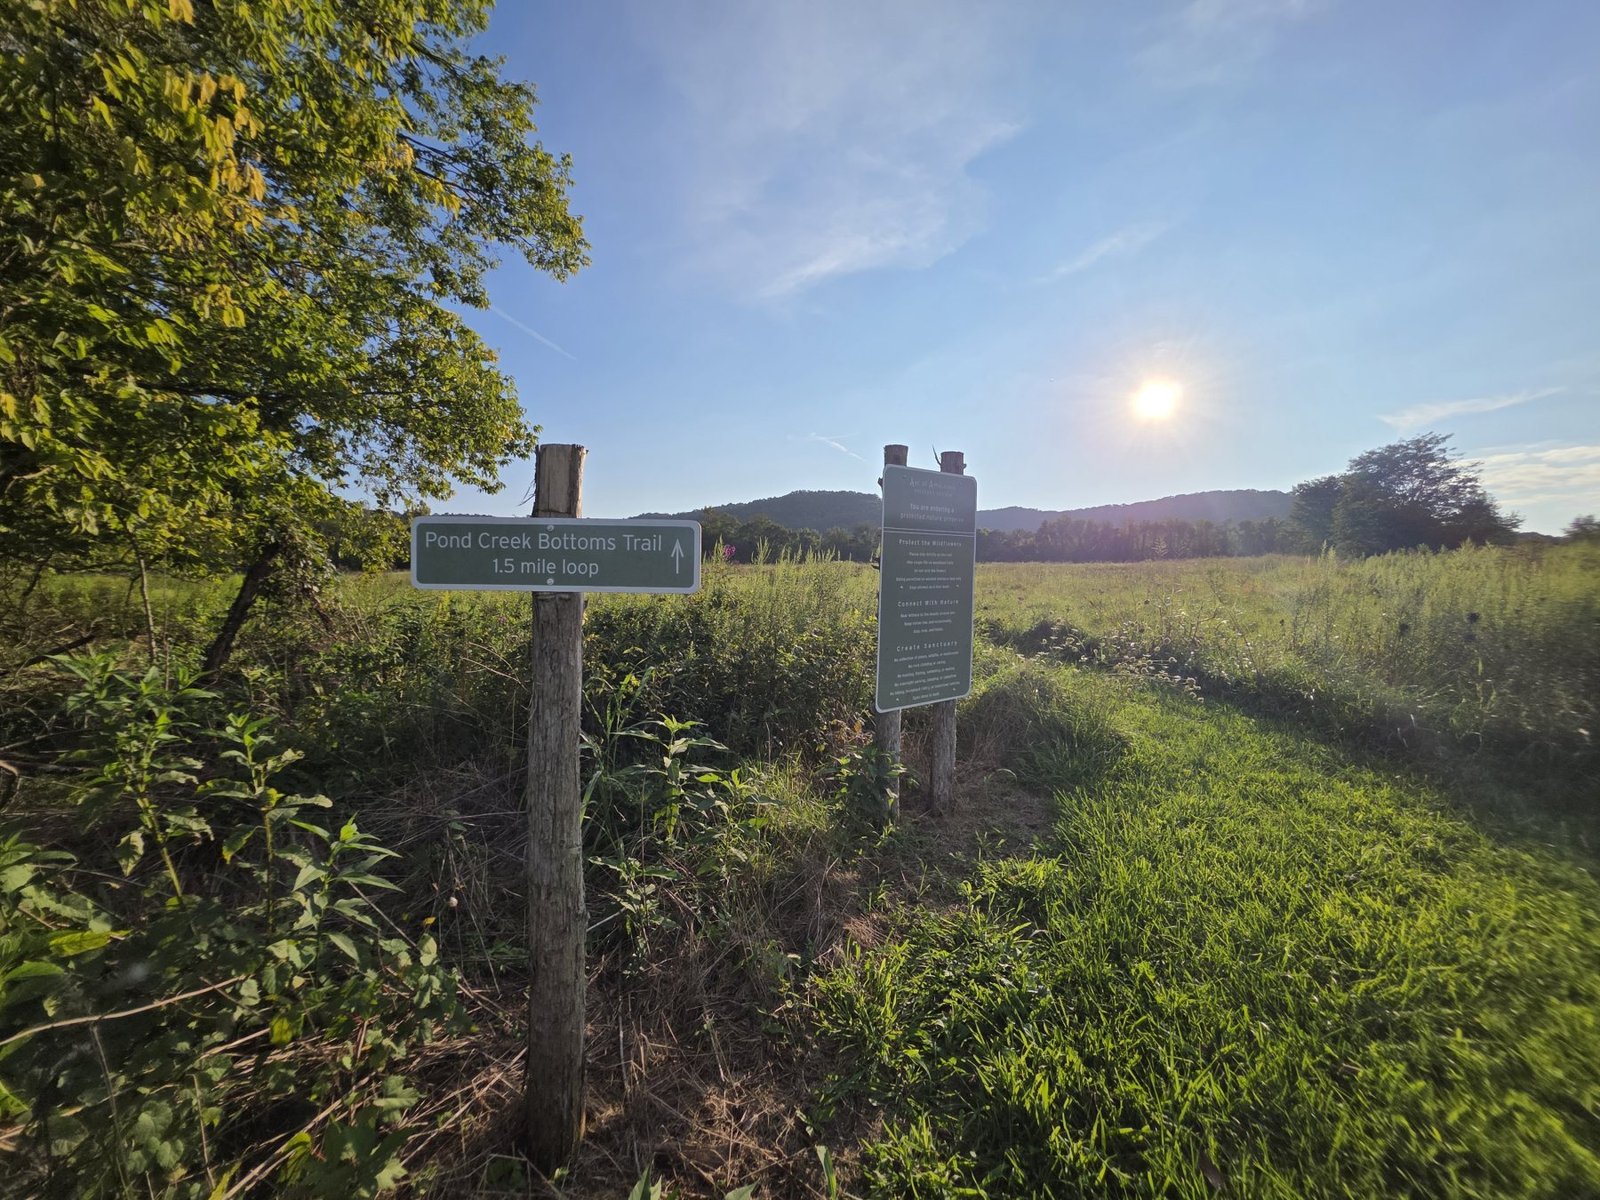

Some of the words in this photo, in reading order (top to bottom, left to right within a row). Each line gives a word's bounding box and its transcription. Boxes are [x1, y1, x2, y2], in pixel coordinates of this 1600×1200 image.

[425, 532, 472, 549] Pond
[478, 532, 532, 550] Creek
[538, 533, 616, 551] Bottoms
[622, 534, 662, 551] Trail
[493, 558, 514, 573] 1.5
[520, 558, 556, 575] mile
[562, 559, 599, 578] loop
